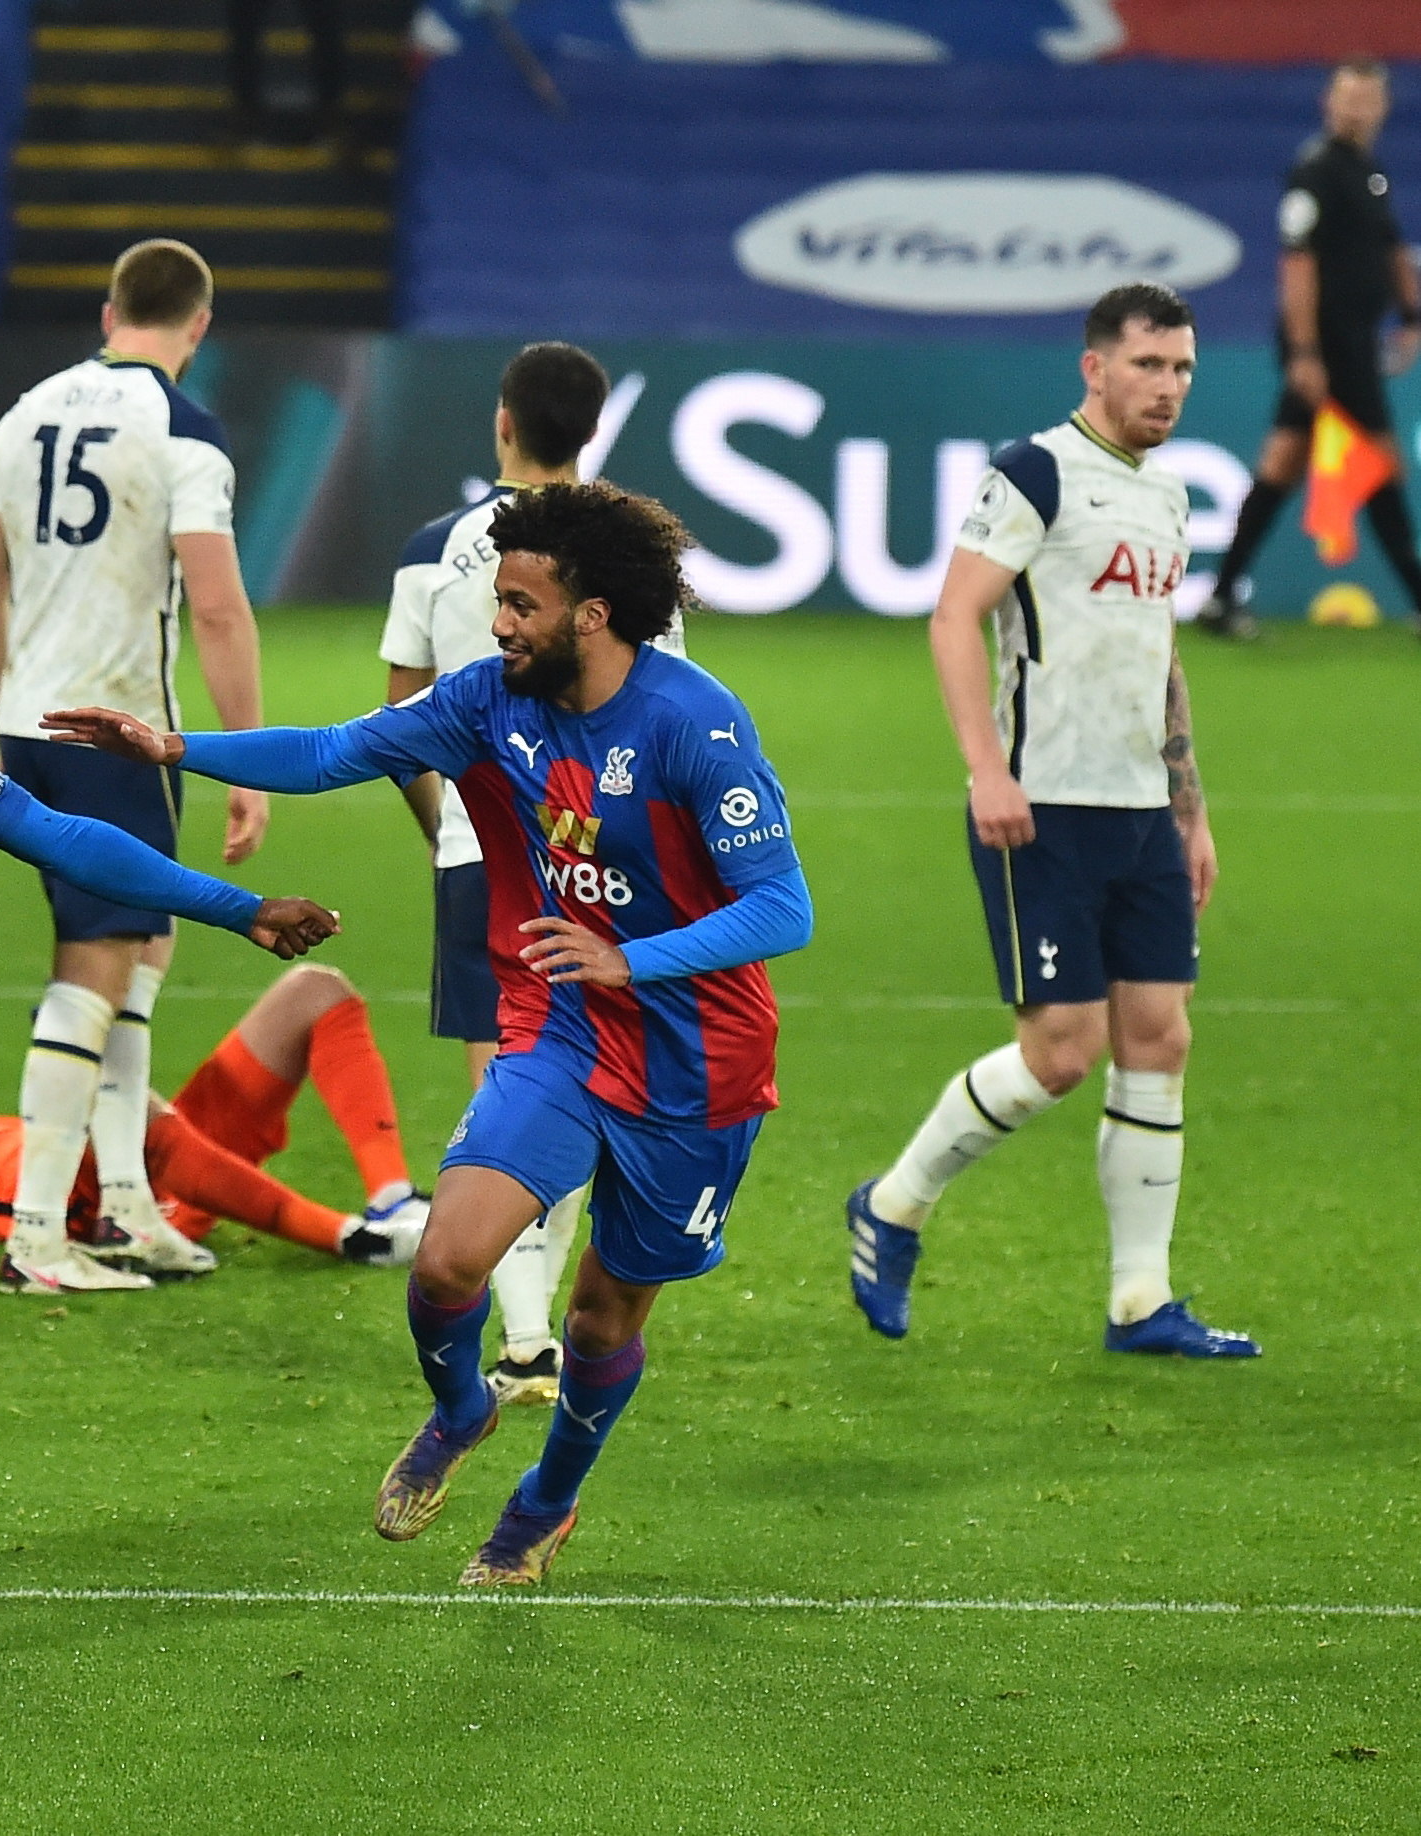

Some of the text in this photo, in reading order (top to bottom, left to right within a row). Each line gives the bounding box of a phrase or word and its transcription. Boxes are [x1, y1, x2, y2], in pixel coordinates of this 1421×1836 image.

[34, 424, 118, 545] 15
[671, 370, 1254, 617] Sue
[536, 850, 633, 906] W88
[710, 823, 785, 854] IQONIQ
